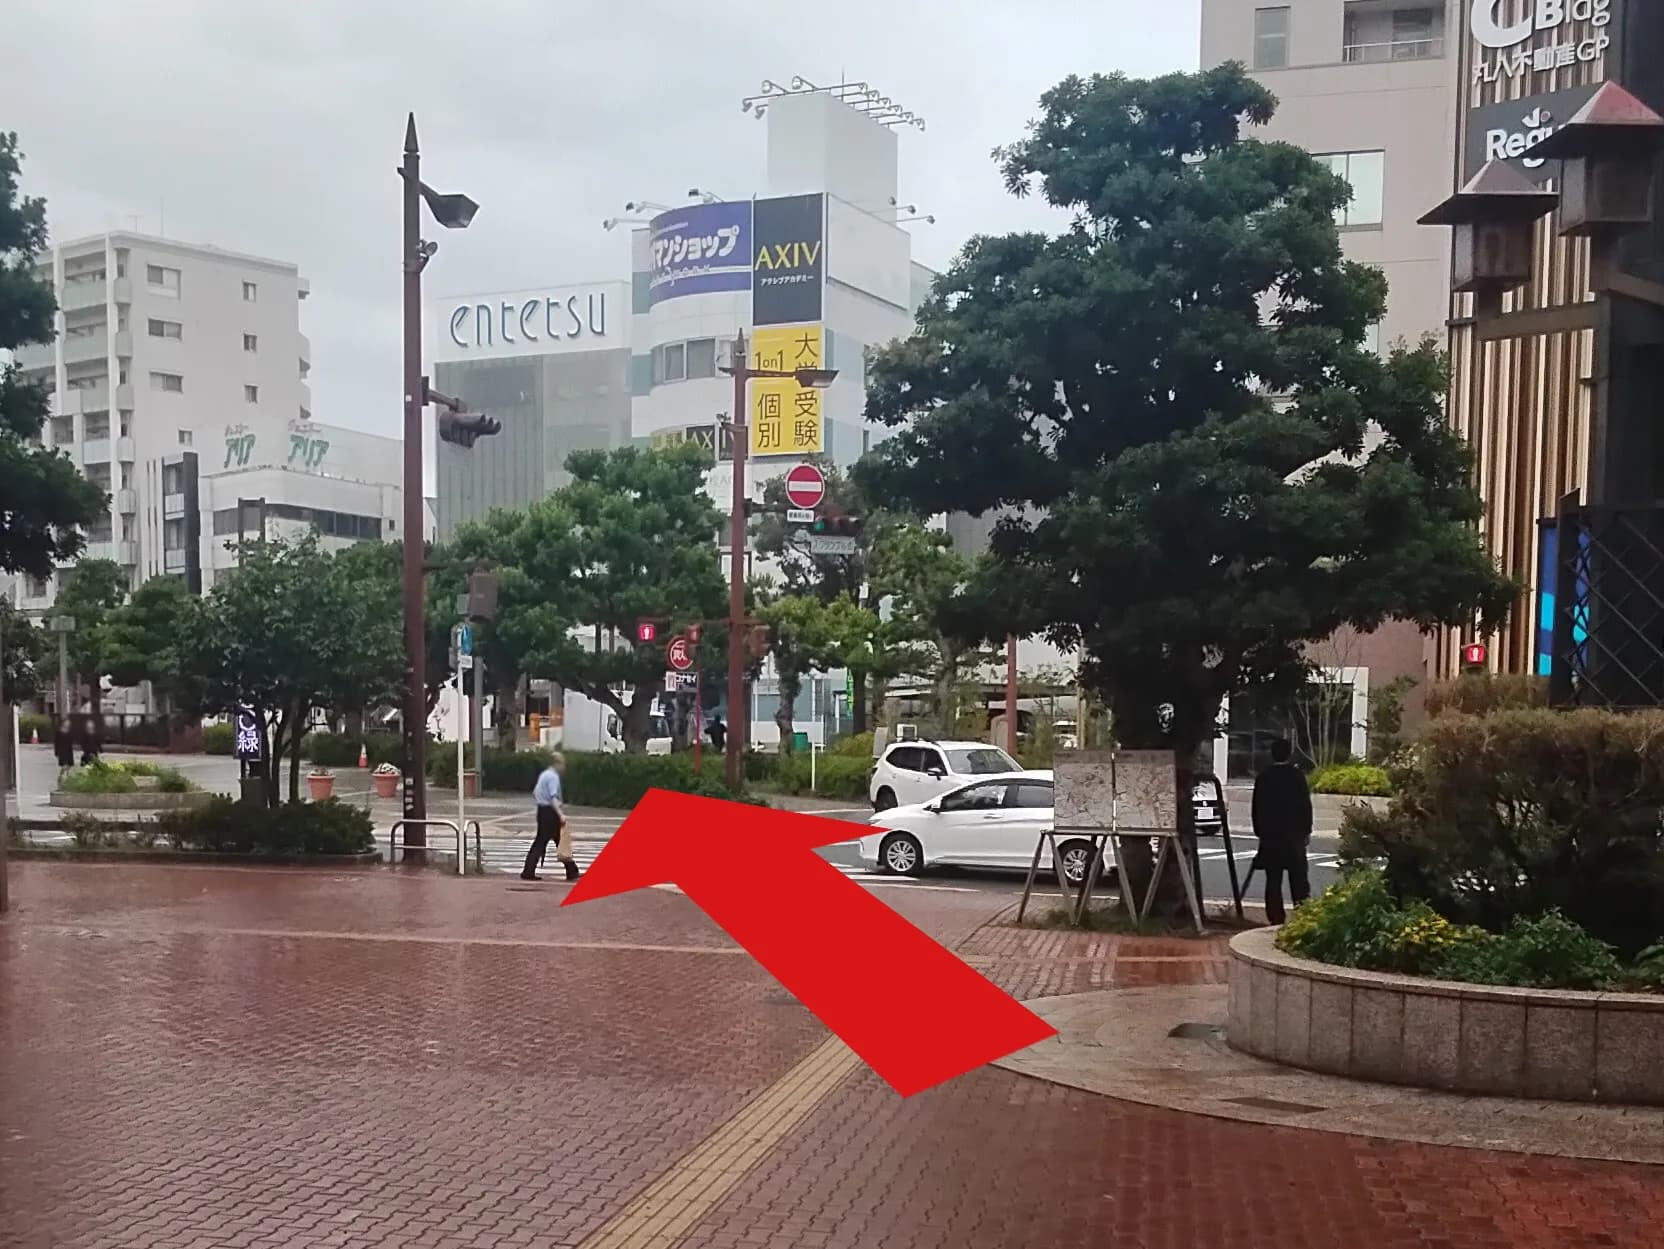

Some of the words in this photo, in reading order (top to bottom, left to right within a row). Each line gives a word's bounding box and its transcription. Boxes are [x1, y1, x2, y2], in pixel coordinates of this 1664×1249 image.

[1486, 124, 1567, 168] Reg
[754, 240, 821, 271] AXIV
[450, 293, 606, 348] entetsu
[754, 349, 784, 371] 1on1
[757, 392, 781, 449] 個別
